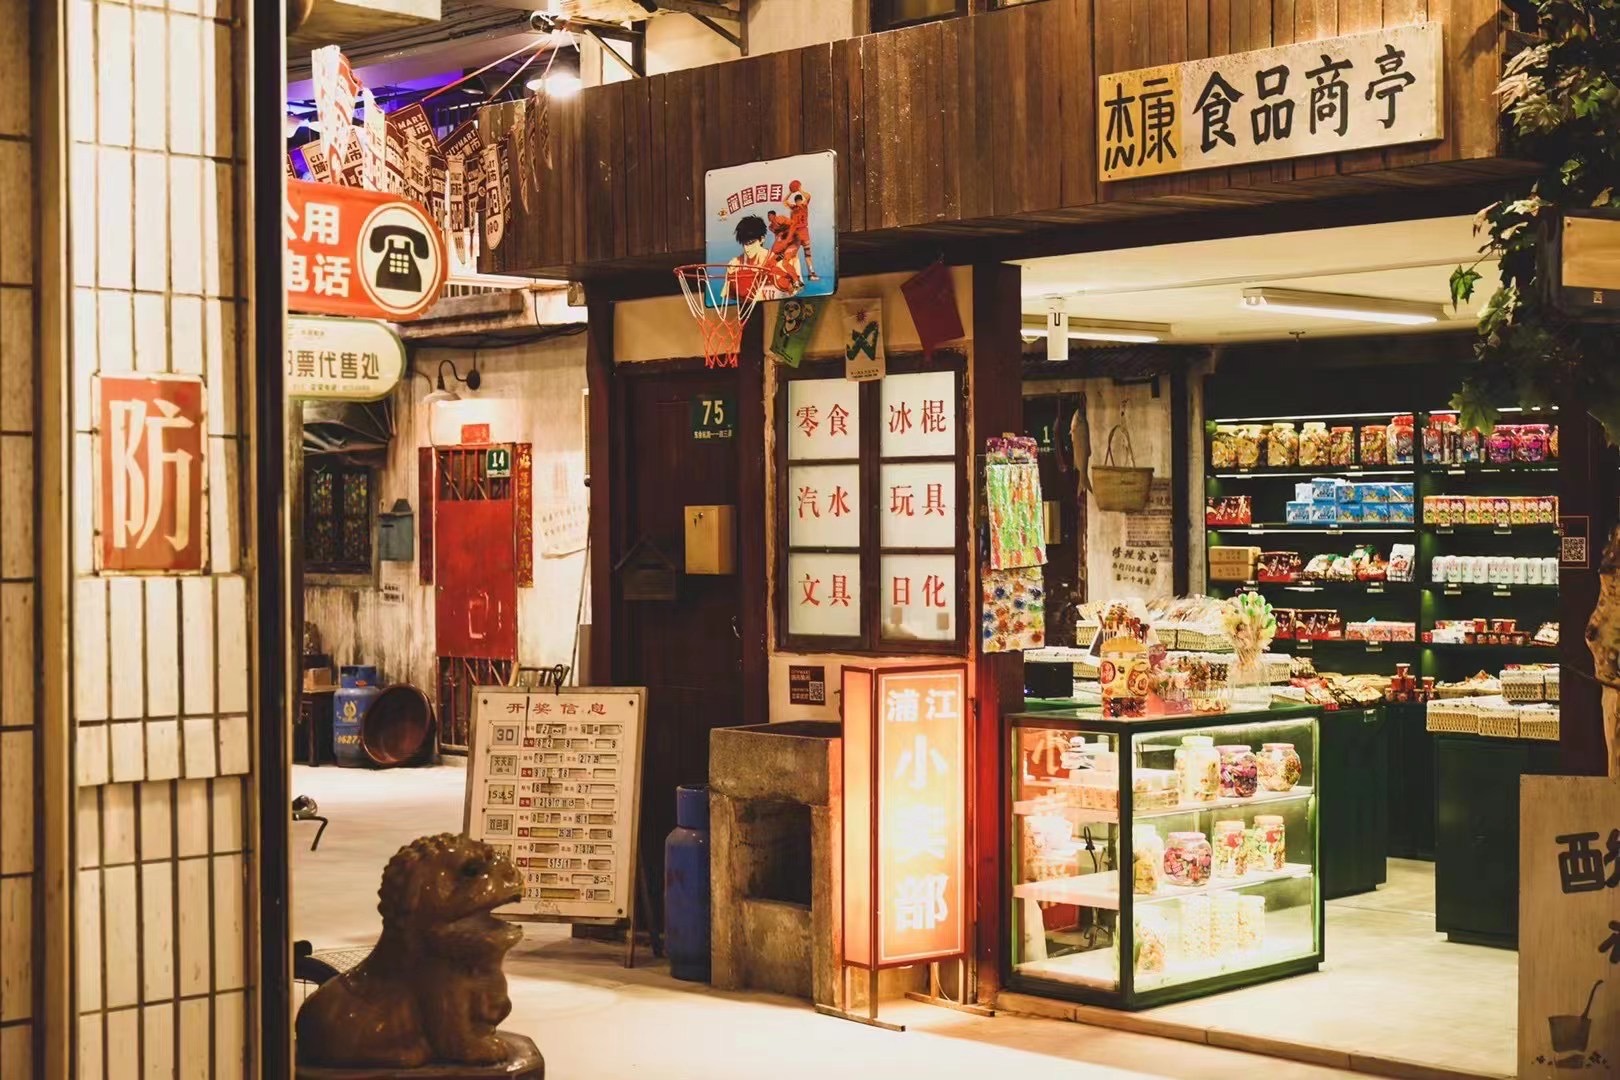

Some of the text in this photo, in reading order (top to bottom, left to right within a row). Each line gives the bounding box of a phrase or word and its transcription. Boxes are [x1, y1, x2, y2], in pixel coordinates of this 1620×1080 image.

[1192, 44, 1416, 154] 食品商亭
[287, 249, 352, 298] 电话
[288, 350, 380, 380] 票代售处
[702, 400, 724, 425] 75
[796, 403, 850, 438] 零食
[888, 400, 947, 435] 冰棍
[109, 398, 195, 552] 防
[491, 451, 505, 468] 14
[796, 485, 851, 519] 汽水
[890, 483, 947, 517] 玩具
[798, 573, 852, 607] 文具
[892, 574, 946, 608] 日化
[506, 702, 607, 716] 开奖信息
[496, 728, 514, 741] 3D
